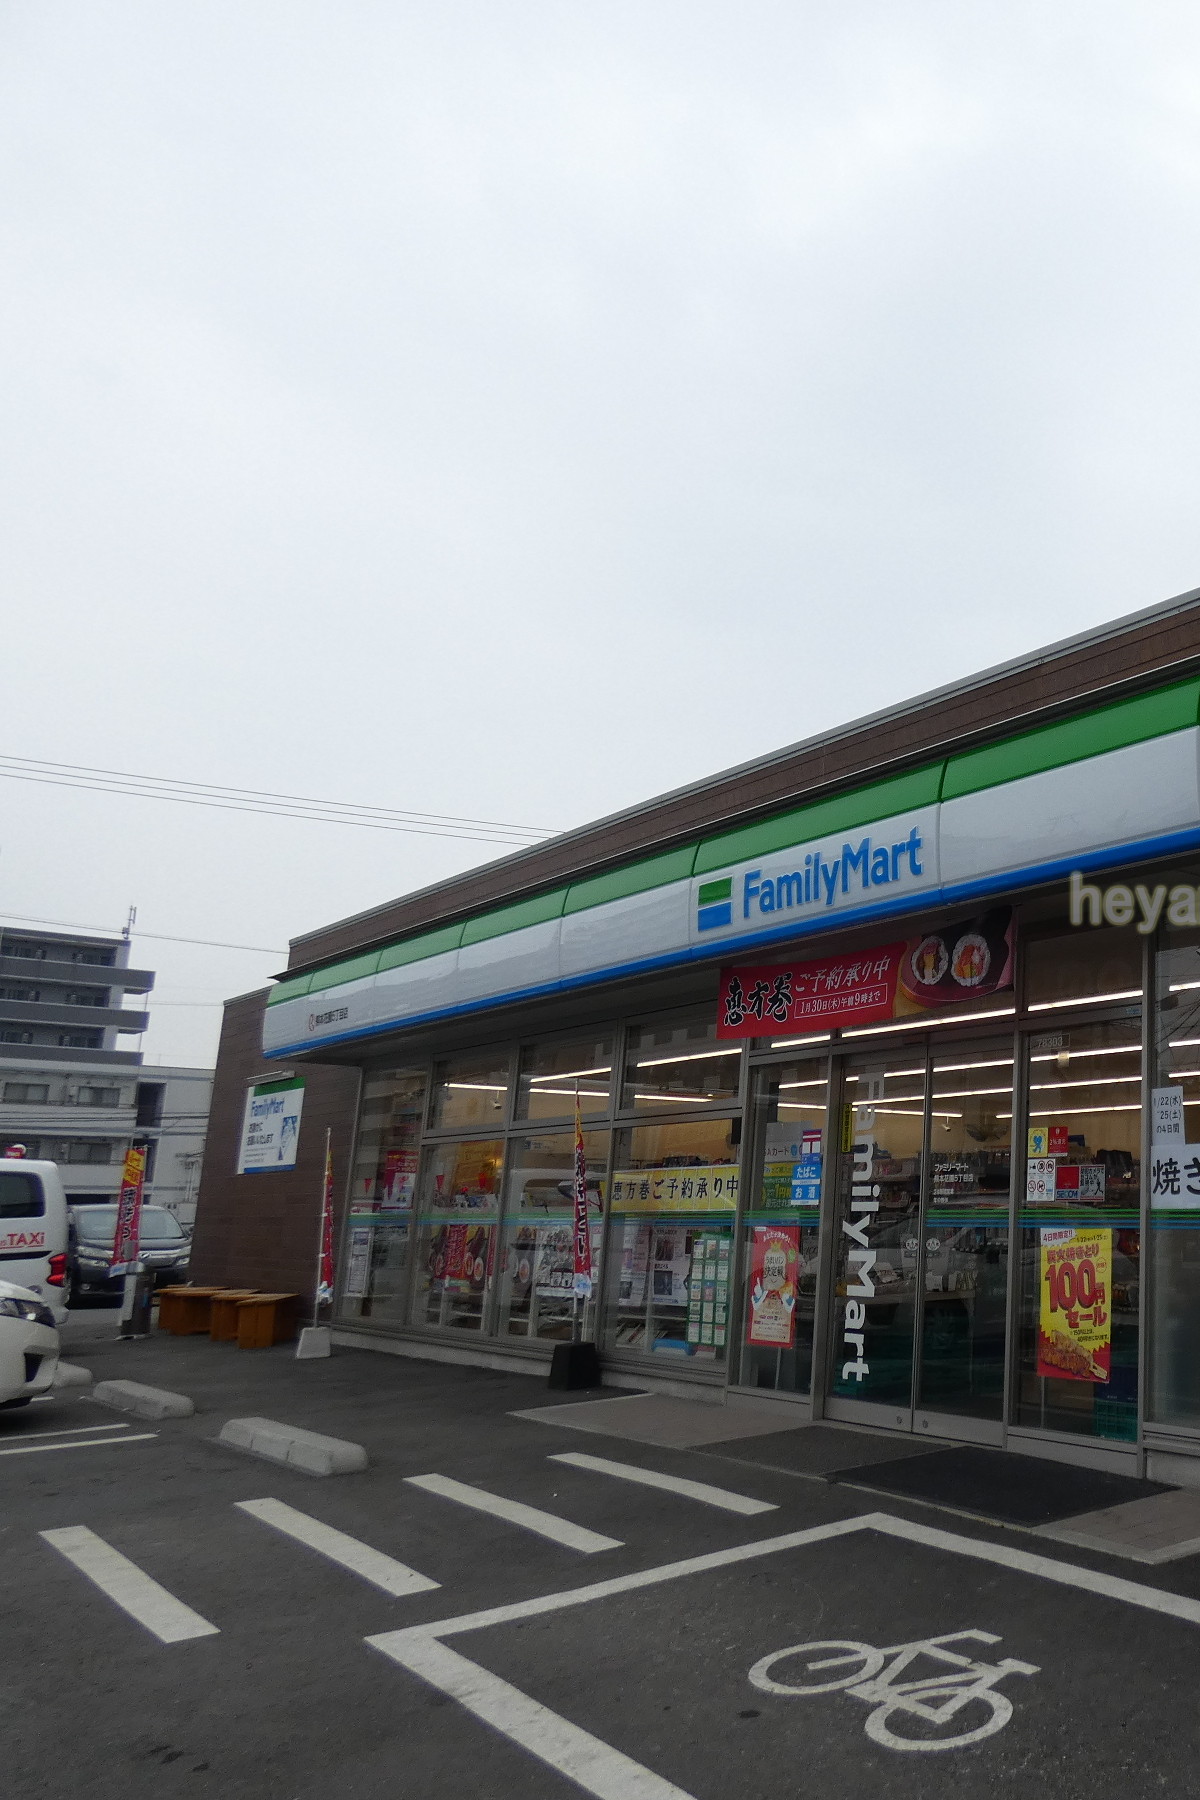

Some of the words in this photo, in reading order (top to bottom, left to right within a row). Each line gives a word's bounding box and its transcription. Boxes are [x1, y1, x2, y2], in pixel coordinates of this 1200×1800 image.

[743, 825, 923, 919] FamilyMart
[795, 955, 891, 993] ご予約承り中
[723, 971, 794, 1027] 恵方巻
[1156, 1123, 1180, 1134] の4日間
[796, 1166, 817, 1178] たばこ
[611, 1175, 739, 1201] 恵方巻ご予約承り中
[795, 1186, 816, 1199] お酒
[1056, 1190, 1078, 1199] SECOM
[842, 1070, 885, 1382] FamilyMart
[1043, 1229, 1073, 1242] 4日間限定!!
[1046, 1243, 1100, 1264] 炭火焼きとり
[1045, 1258, 1106, 1313] 100円
[1065, 1305, 1108, 1328] セール
